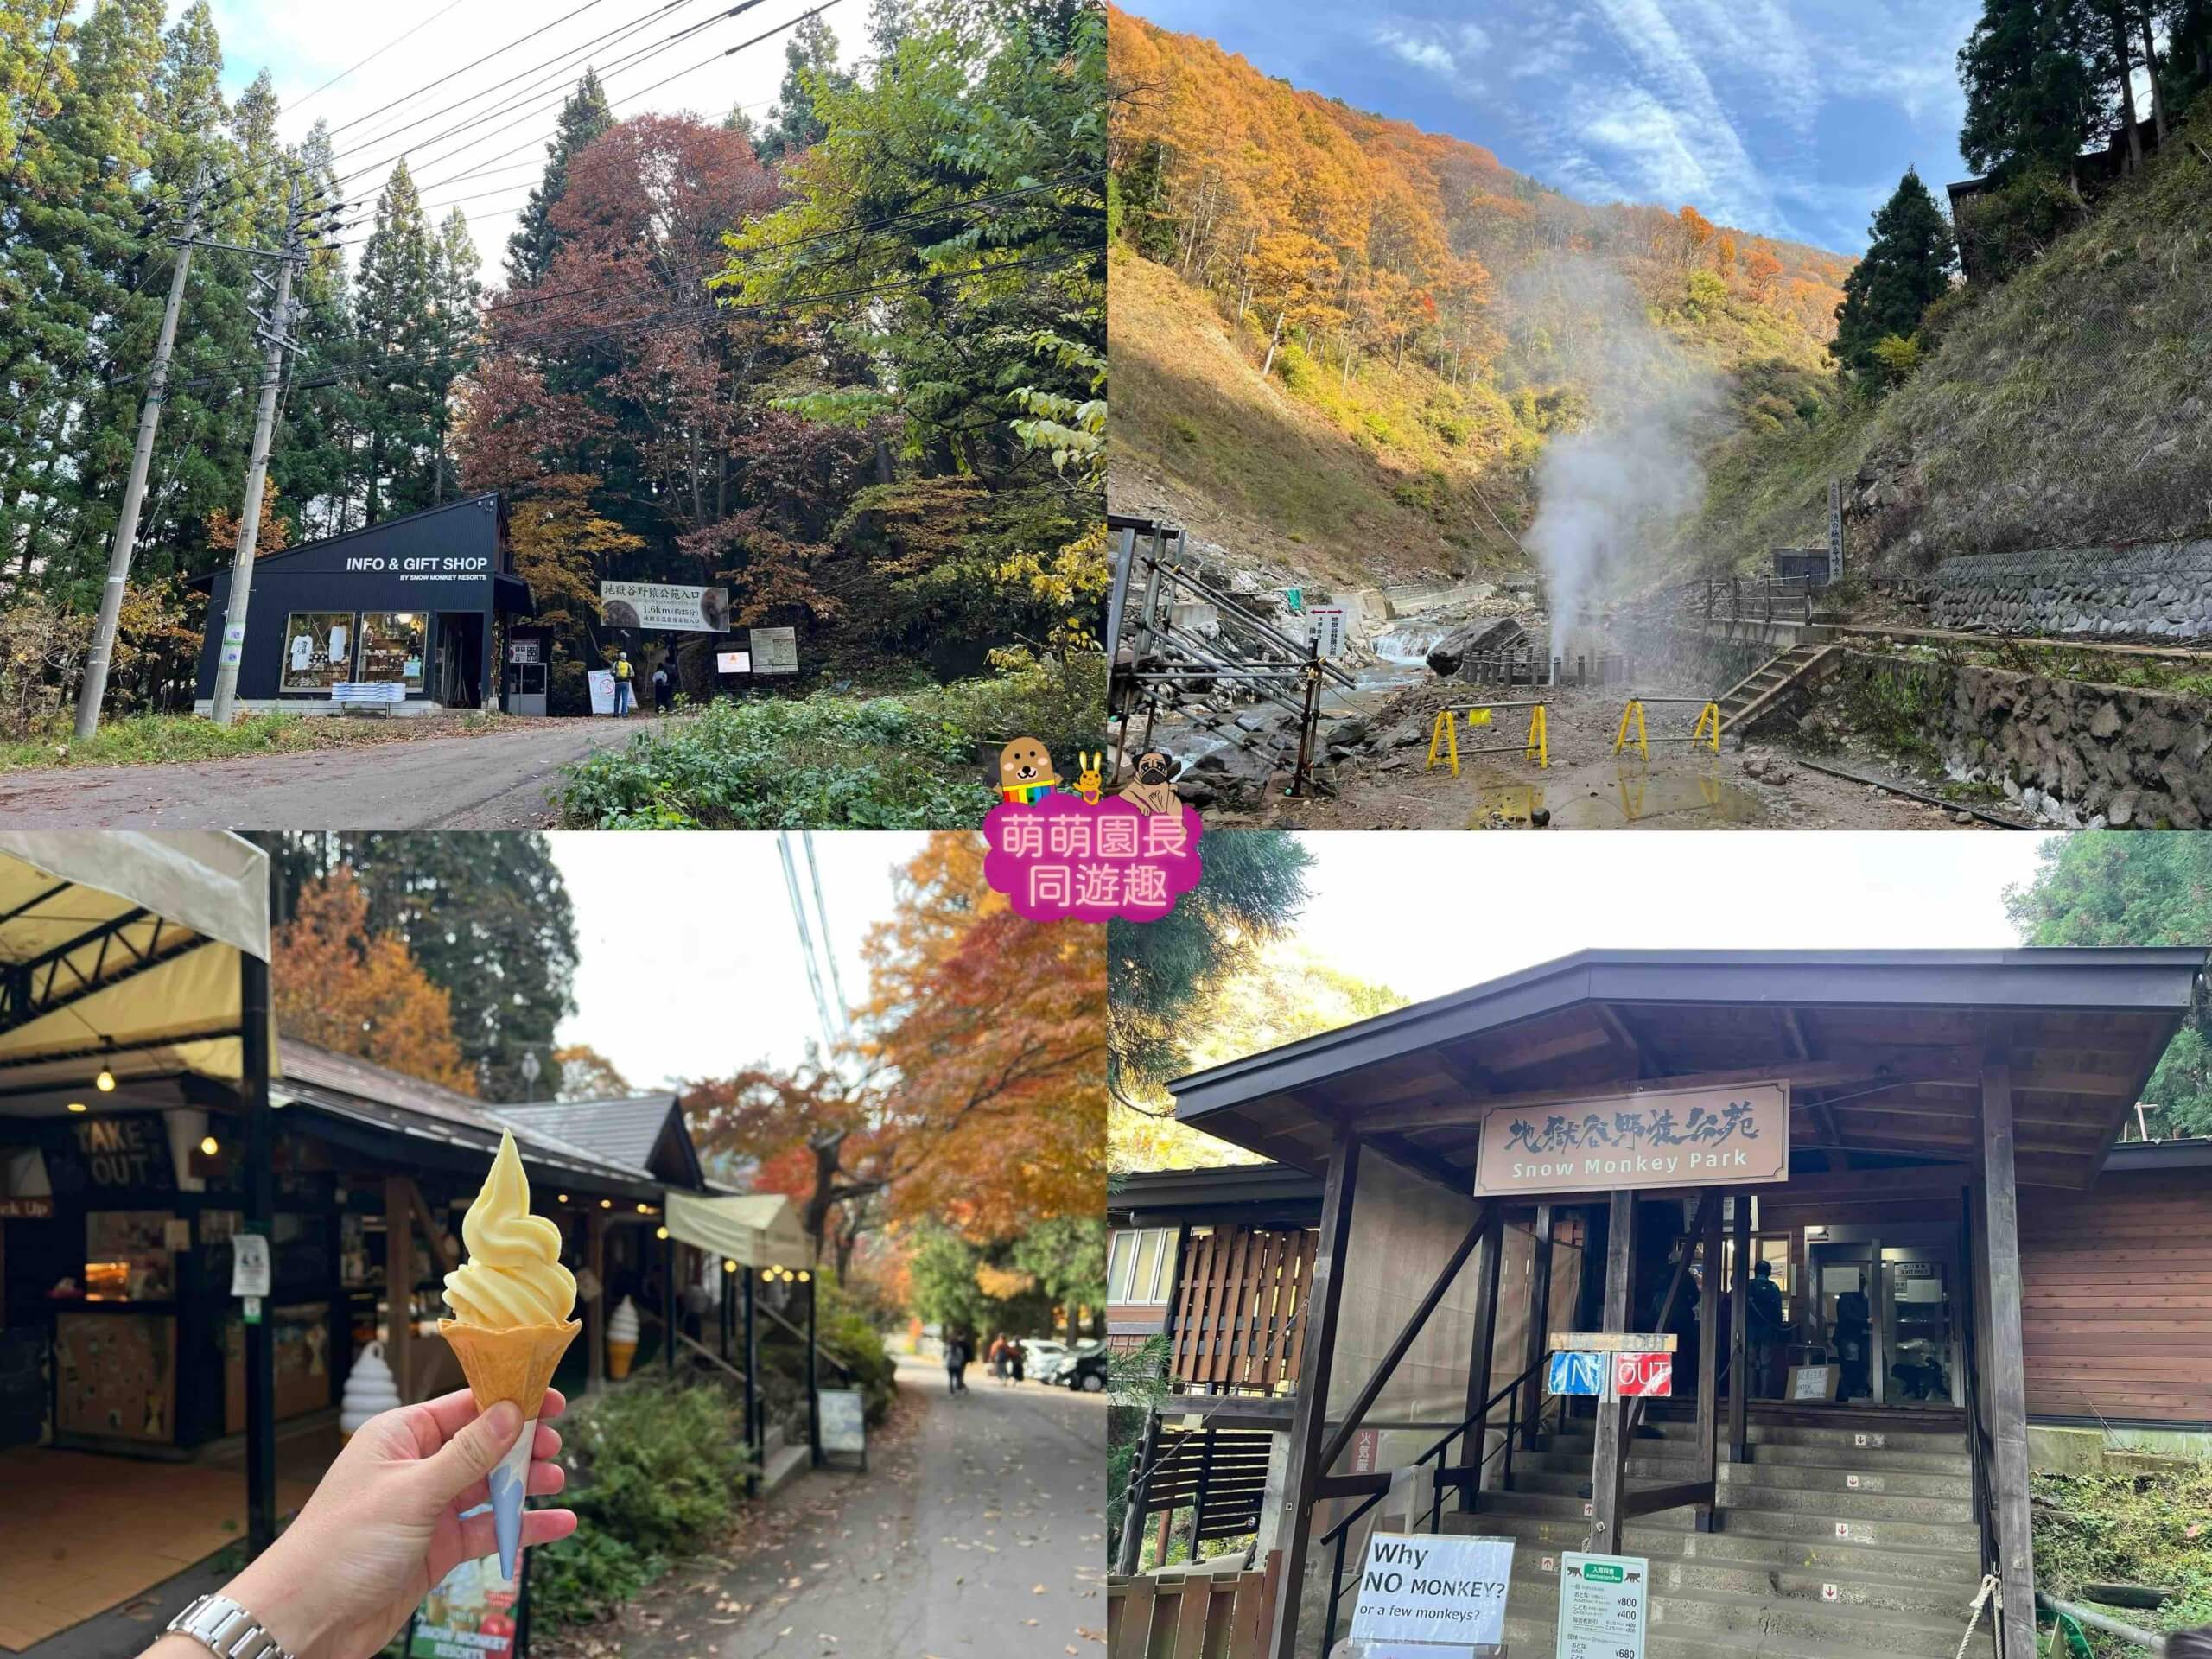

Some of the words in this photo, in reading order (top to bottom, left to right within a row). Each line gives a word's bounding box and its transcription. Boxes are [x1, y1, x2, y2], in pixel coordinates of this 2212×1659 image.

[346, 557, 385, 571] INFO
[389, 557, 400, 571] &
[404, 557, 440, 571] GIFT
[442, 557, 488, 571] SHOP
[604, 584, 699, 600] 地獄谷野猿公苑入口
[644, 605, 671, 614] 1.6km
[72, 1120, 145, 1153] TAKE
[1503, 1101, 1760, 1155] 地獄谷野猿公苑
[91, 1154, 149, 1185] OUT
[1512, 1160, 1574, 1179] Snow
[1584, 1154, 1679, 1175] Monkey
[1689, 1148, 1748, 1168] Park
[1618, 1361, 1669, 1385] OUT
[1374, 1542, 1428, 1570] Why
[1363, 1571, 1402, 1593] NO
[1410, 1578, 1505, 1599] MONKEY?
[1617, 1597, 1637, 1608] ¥800
[1359, 1605, 1374, 1615] or
[1377, 1606, 1385, 1616] a
[1389, 1605, 1412, 1617] few
[1415, 1607, 1480, 1623] monkeys?
[1617, 1610, 1637, 1620] ¥400
[1614, 1649, 1636, 1659] ¥680
